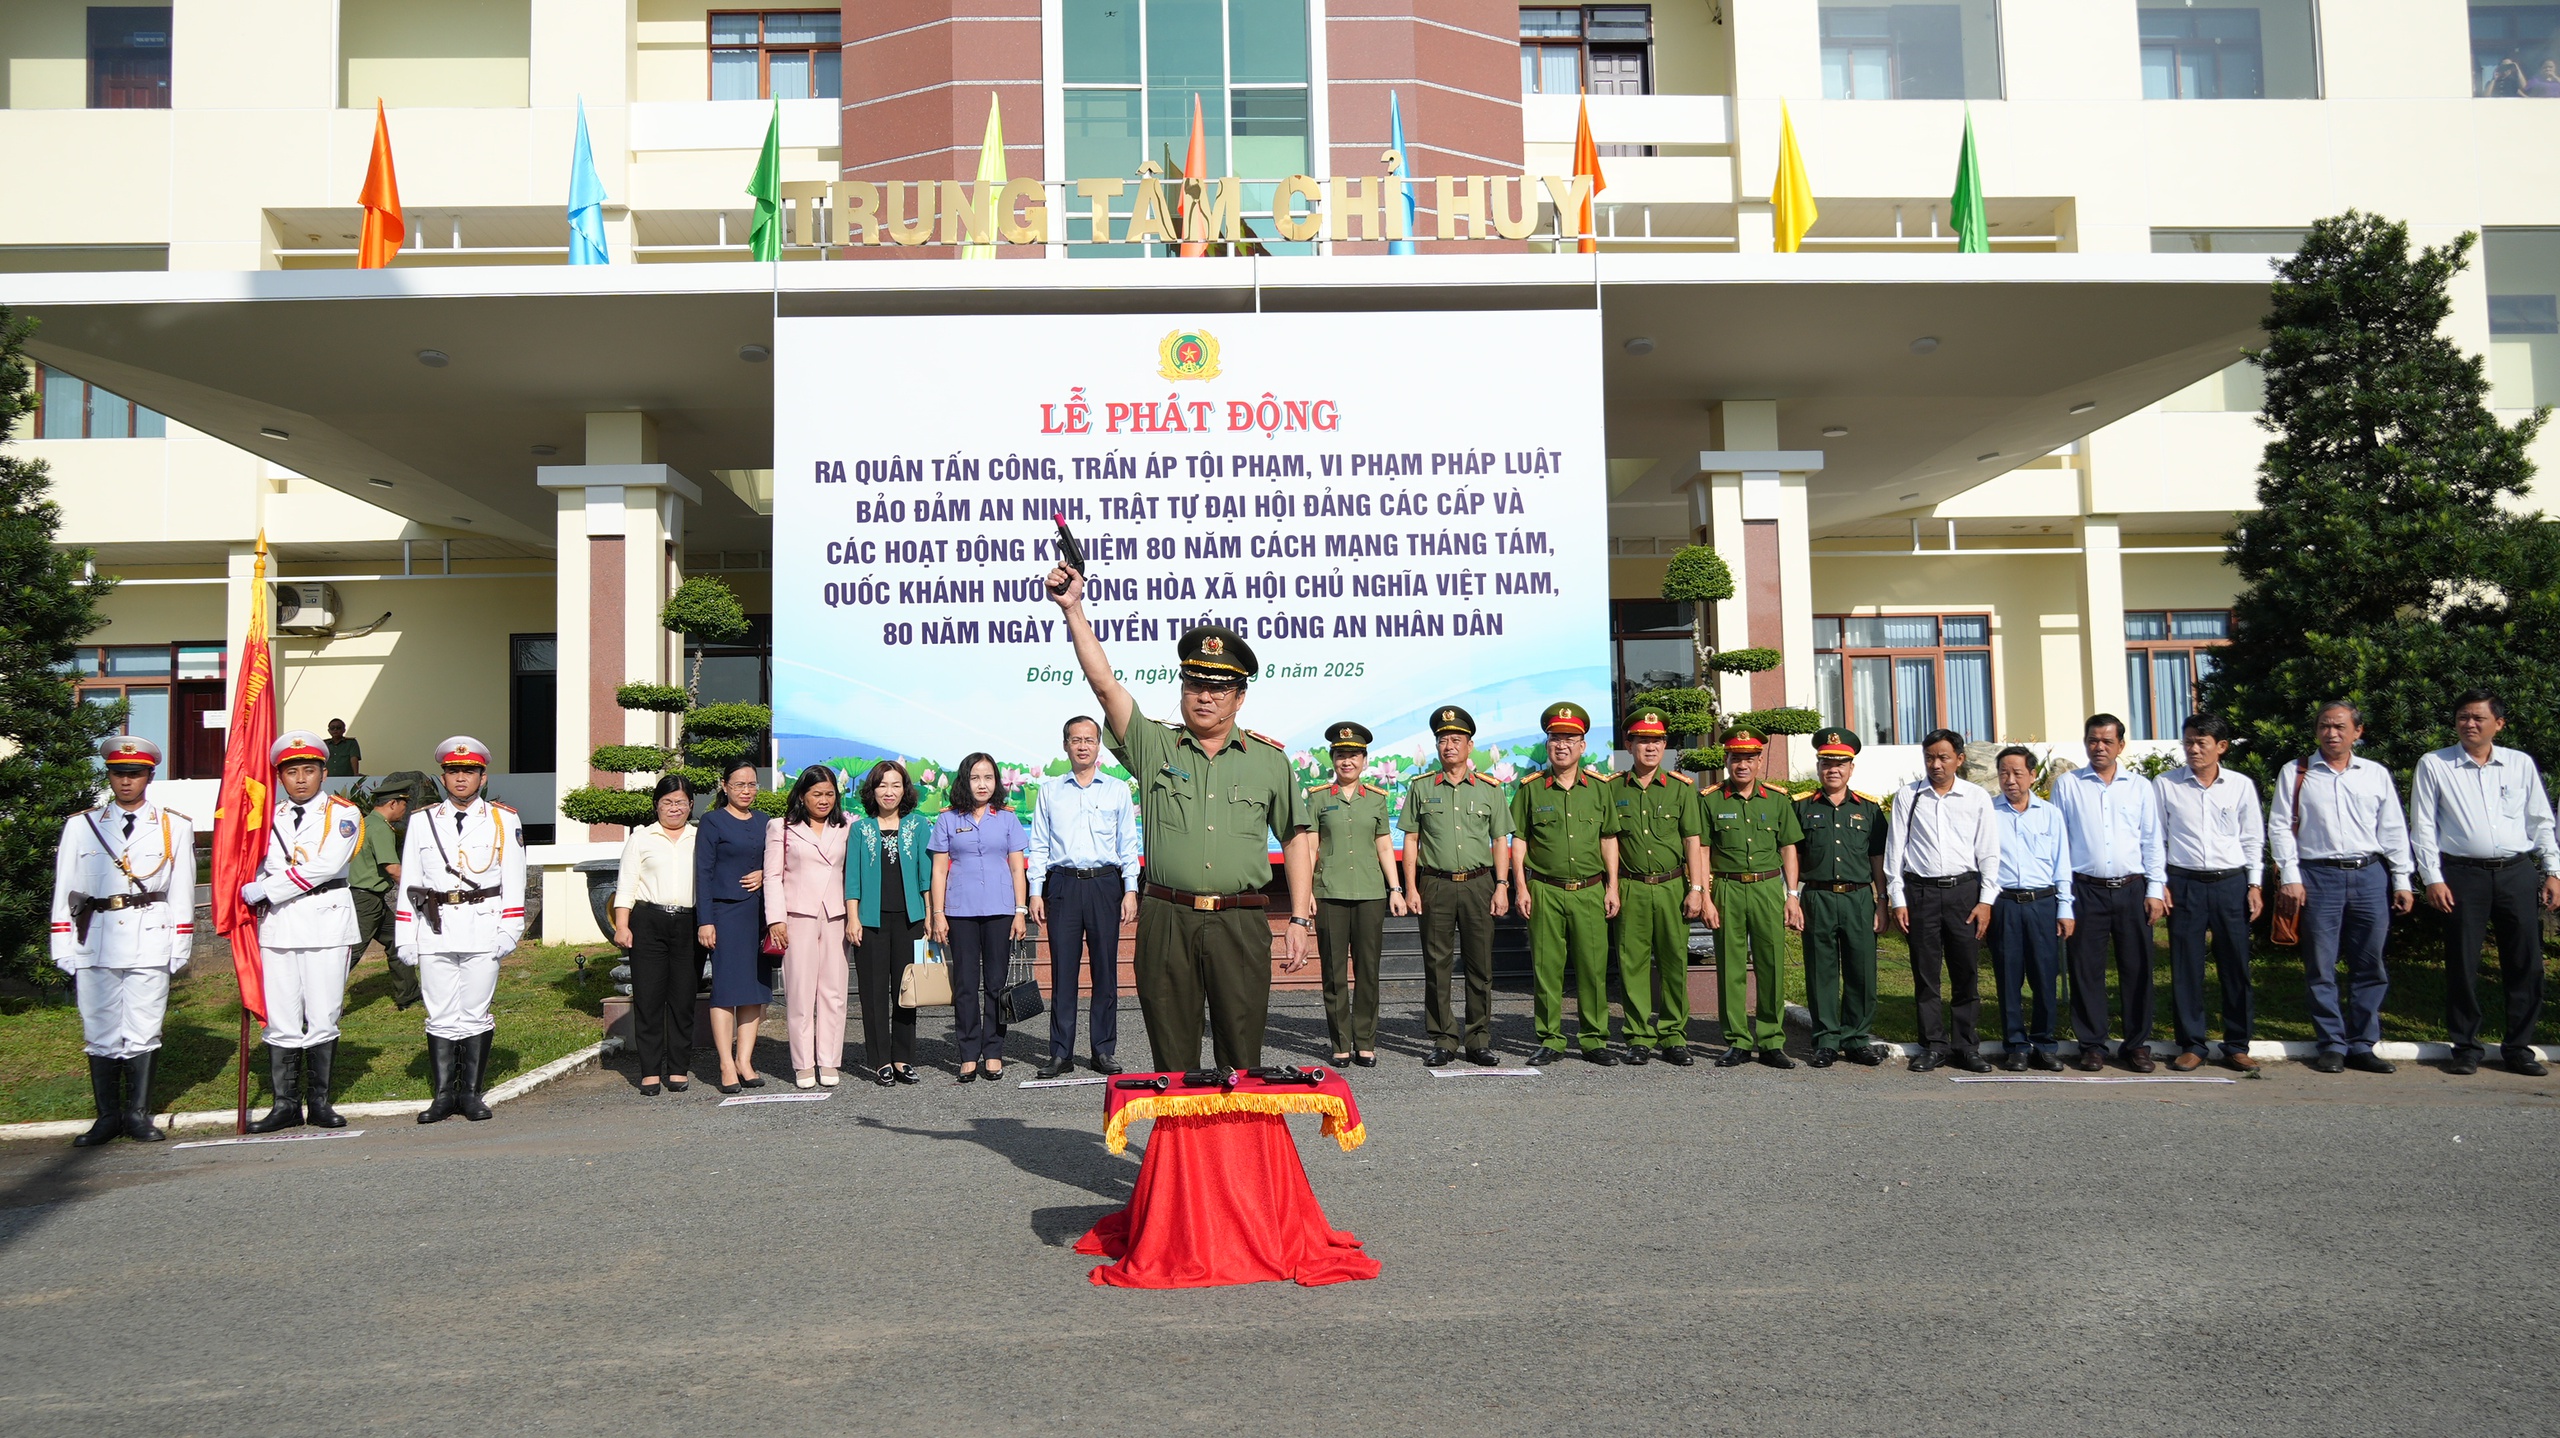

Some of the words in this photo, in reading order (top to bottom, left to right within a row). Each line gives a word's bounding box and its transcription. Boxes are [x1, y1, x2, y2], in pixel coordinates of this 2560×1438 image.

[781, 177, 1048, 246] TRUNG
[1077, 161, 1240, 243] TÂM
[1272, 149, 1403, 242] CHỈ
[1436, 174, 1594, 241] HUY
[1040, 386, 1092, 435] LỄ
[1105, 392, 1214, 434] PHÁT
[1226, 391, 1340, 440] ĐỘNG
[815, 460, 847, 484] RA
[855, 454, 923, 486] QUÂN
[931, 450, 980, 482] TẤN
[988, 453, 1064, 483] CÔNG,
[1071, 448, 1137, 480] TRẤN
[1144, 451, 1178, 479] ÁP
[1185, 450, 1224, 484] TỘI
[1232, 454, 1312, 483] PHẠM,
[1319, 454, 1343, 477] VI
[1351, 453, 1423, 481] PHẠM
[1431, 447, 1496, 476] PHÁP
[1504, 446, 1562, 479] LUẬT
[856, 492, 906, 524] BẢO
[913, 491, 971, 523] ĐẢM
[979, 498, 1014, 522] AN
[1022, 497, 1091, 524] NINH,
[1098, 492, 1160, 525] TRẬT
[1166, 494, 1200, 524] TỰ
[1204, 495, 1246, 524] ĐẠI
[1254, 489, 1295, 523] HỘI
[1303, 486, 1371, 517] ĐẢNG
[1379, 488, 1428, 517] CÁC
[1437, 484, 1485, 516] CẤP
[1493, 487, 1525, 515] VÀ
[826, 536, 876, 565] CÁC
[885, 540, 949, 568] HOẠT
[955, 534, 1025, 567] ĐỘNG
[1146, 537, 1176, 560] 80
[1184, 531, 1242, 560] NĂM
[1250, 530, 1316, 559] CÁCH
[1324, 533, 1399, 562] MẠNG
[1406, 528, 1487, 556] THÁNG
[1494, 526, 1555, 557] TÁM,
[823, 573, 891, 606] QUỐC
[899, 575, 985, 605] KHÁNH
[992, 574, 1058, 603] NƯỚ
[1079, 573, 1138, 607] ỘNG
[1146, 571, 1197, 601] HÒA
[1204, 571, 1238, 600] XÃ
[1245, 570, 1286, 604] HỘI
[1295, 566, 1344, 599] CHỦ
[1352, 569, 1429, 598] NGHĨA
[1435, 568, 1487, 601] VIỆT
[1495, 571, 1559, 597] NAM,
[883, 622, 913, 646] 80
[921, 616, 980, 645] NĂM
[988, 614, 1055, 644] NGÀY
[1062, 610, 1159, 643] TUYỀN
[1257, 611, 1325, 640] CÔNG
[1332, 615, 1367, 639] AN
[1375, 609, 1444, 638] NHÂN
[1452, 608, 1503, 637] DÂN
[1026, 664, 1074, 686] Đồng
[1135, 664, 1178, 685] ngày
[1265, 663, 1276, 679] 8
[1281, 662, 1318, 678] năm
[1324, 662, 1365, 678] 2025
